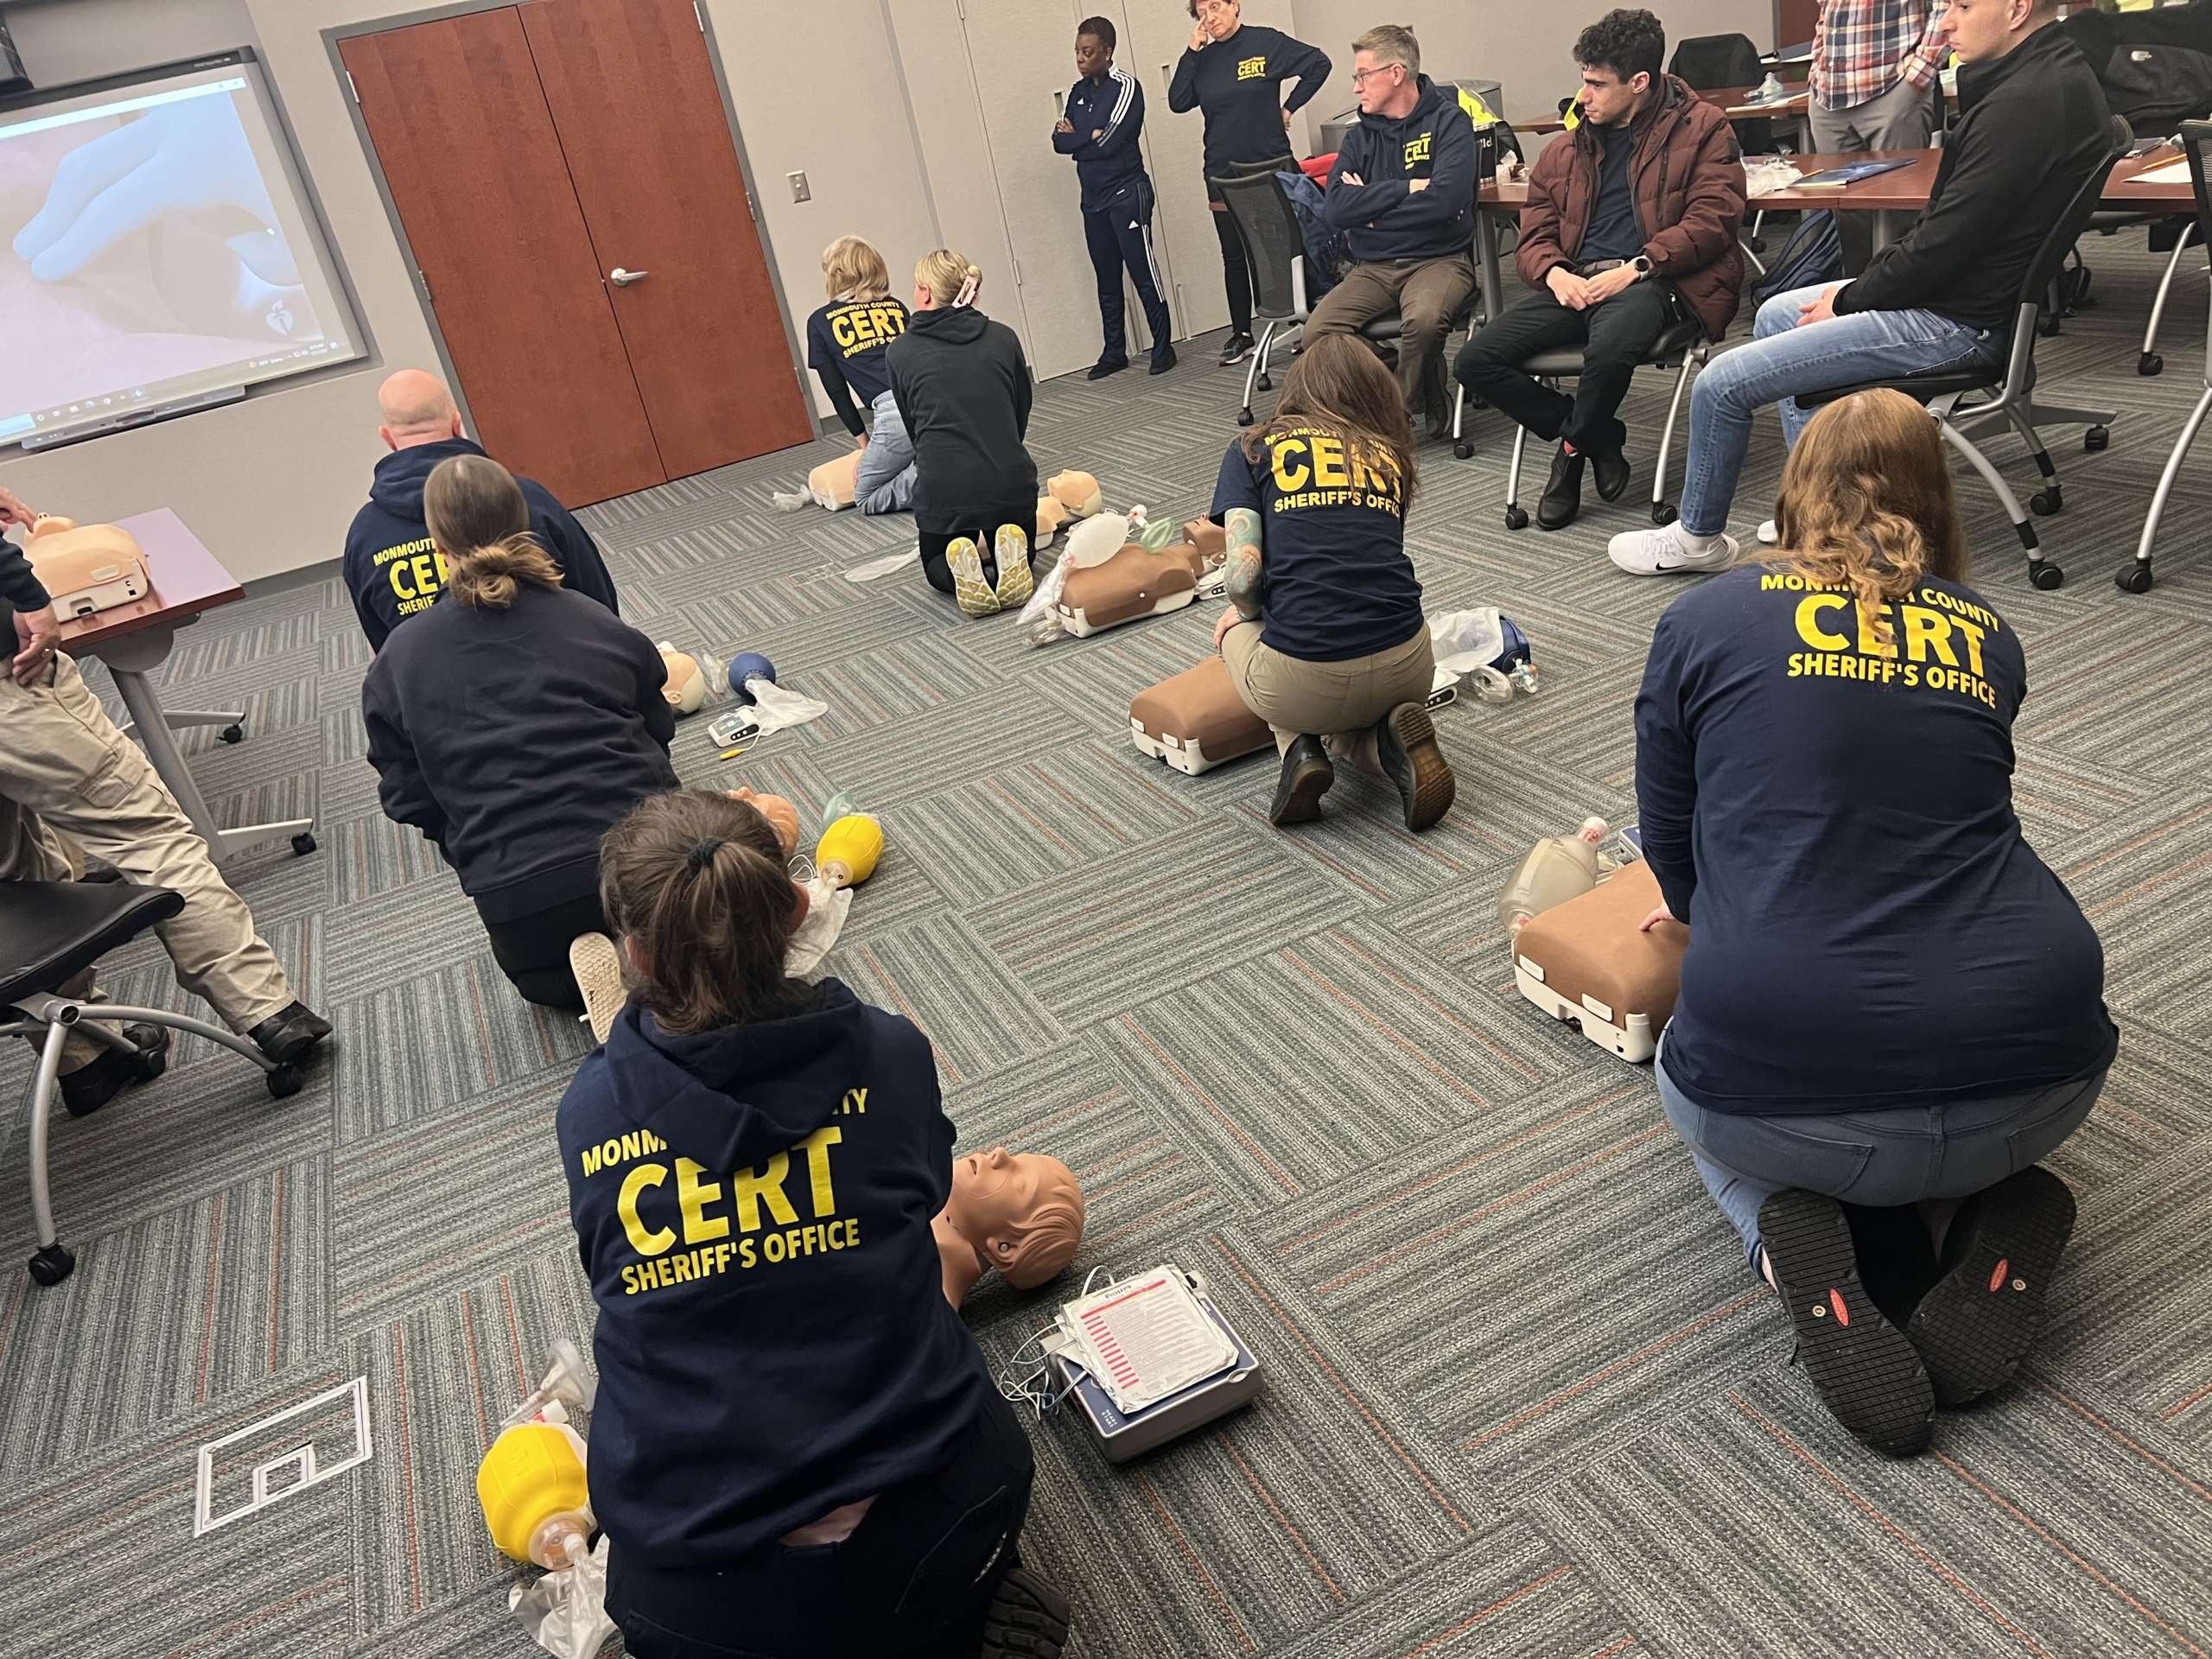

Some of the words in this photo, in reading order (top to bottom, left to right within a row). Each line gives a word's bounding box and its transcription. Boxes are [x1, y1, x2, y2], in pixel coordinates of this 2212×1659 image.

[1238, 60, 1266, 77] CERT
[832, 308, 906, 347] CERT
[1271, 437, 1402, 503] CERT
[1274, 491, 1362, 513] SHERIFF'S
[1366, 494, 1400, 518] OFFIC
[389, 552, 450, 600] CE
[397, 594, 436, 616] SHERIF
[1921, 588, 1999, 632] COUNTY
[1795, 594, 1986, 678] CERT
[1787, 653, 1920, 687] SHERIFF'S
[1925, 666, 1997, 710] OFFICE
[581, 1128, 668, 1178] MONM
[617, 1125, 843, 1256] CERT
[620, 1237, 758, 1295] SHERIFF'S
[762, 1217, 861, 1263] OFFICE
